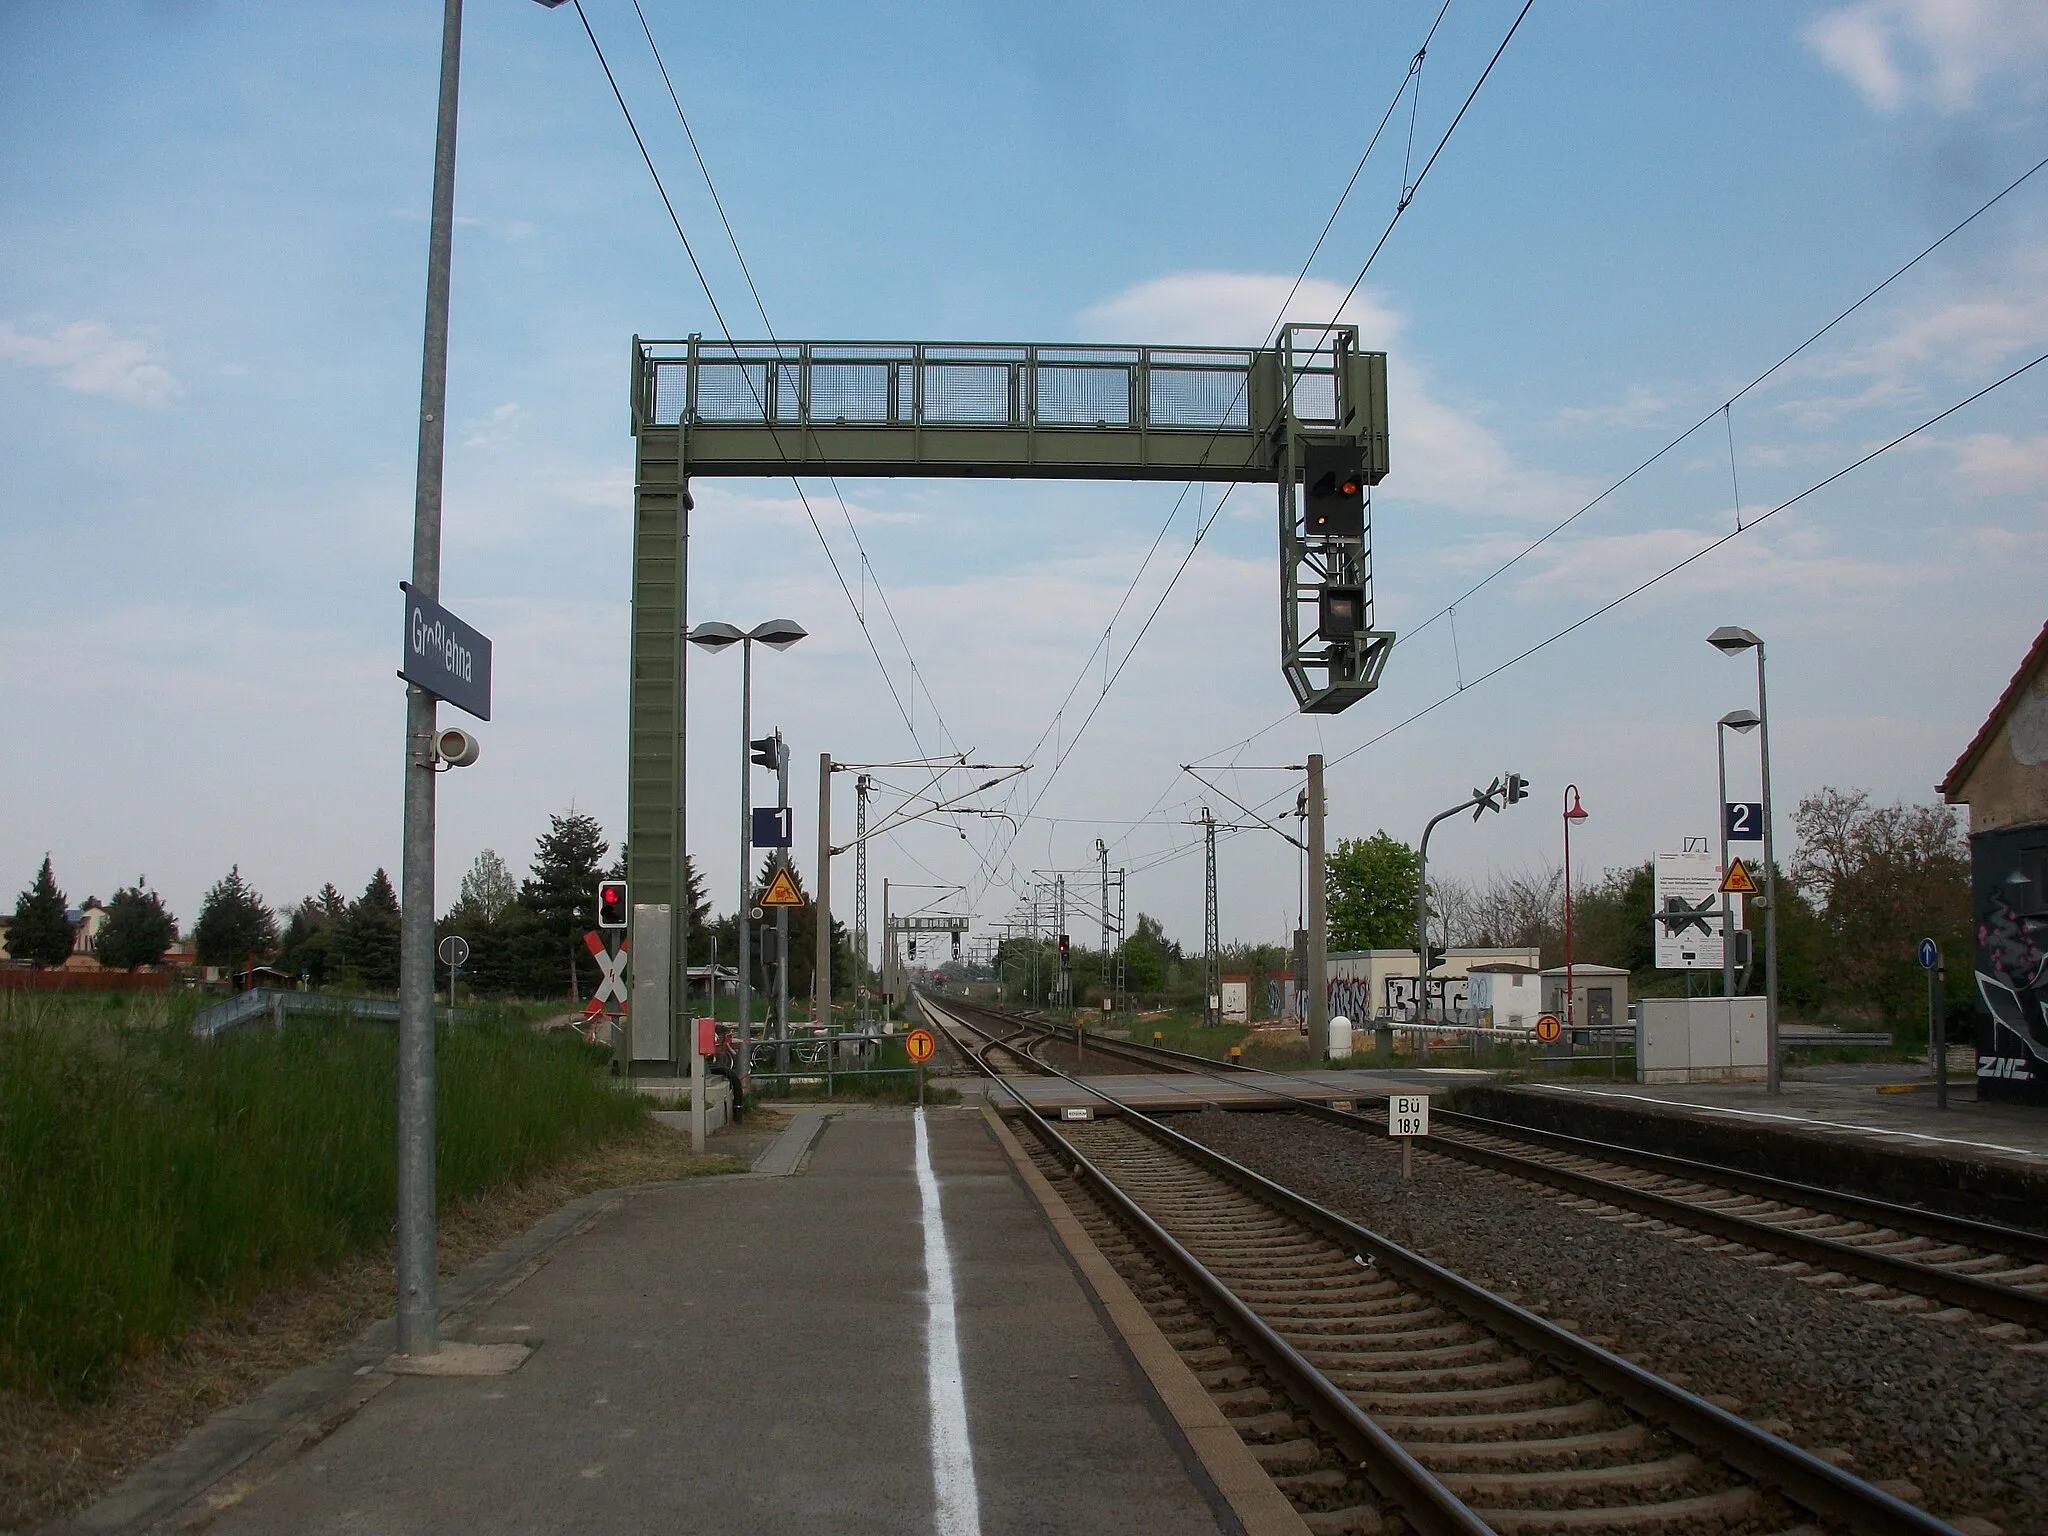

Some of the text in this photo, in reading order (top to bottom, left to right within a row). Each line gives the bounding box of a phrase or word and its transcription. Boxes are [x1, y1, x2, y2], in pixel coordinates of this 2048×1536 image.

[412, 606, 472, 684] Großlehna
[774, 808, 787, 838] 1
[1732, 803, 1750, 832] 2
[1398, 1098, 1420, 1114] Bü
[1397, 1118, 1420, 1134] 18,9
